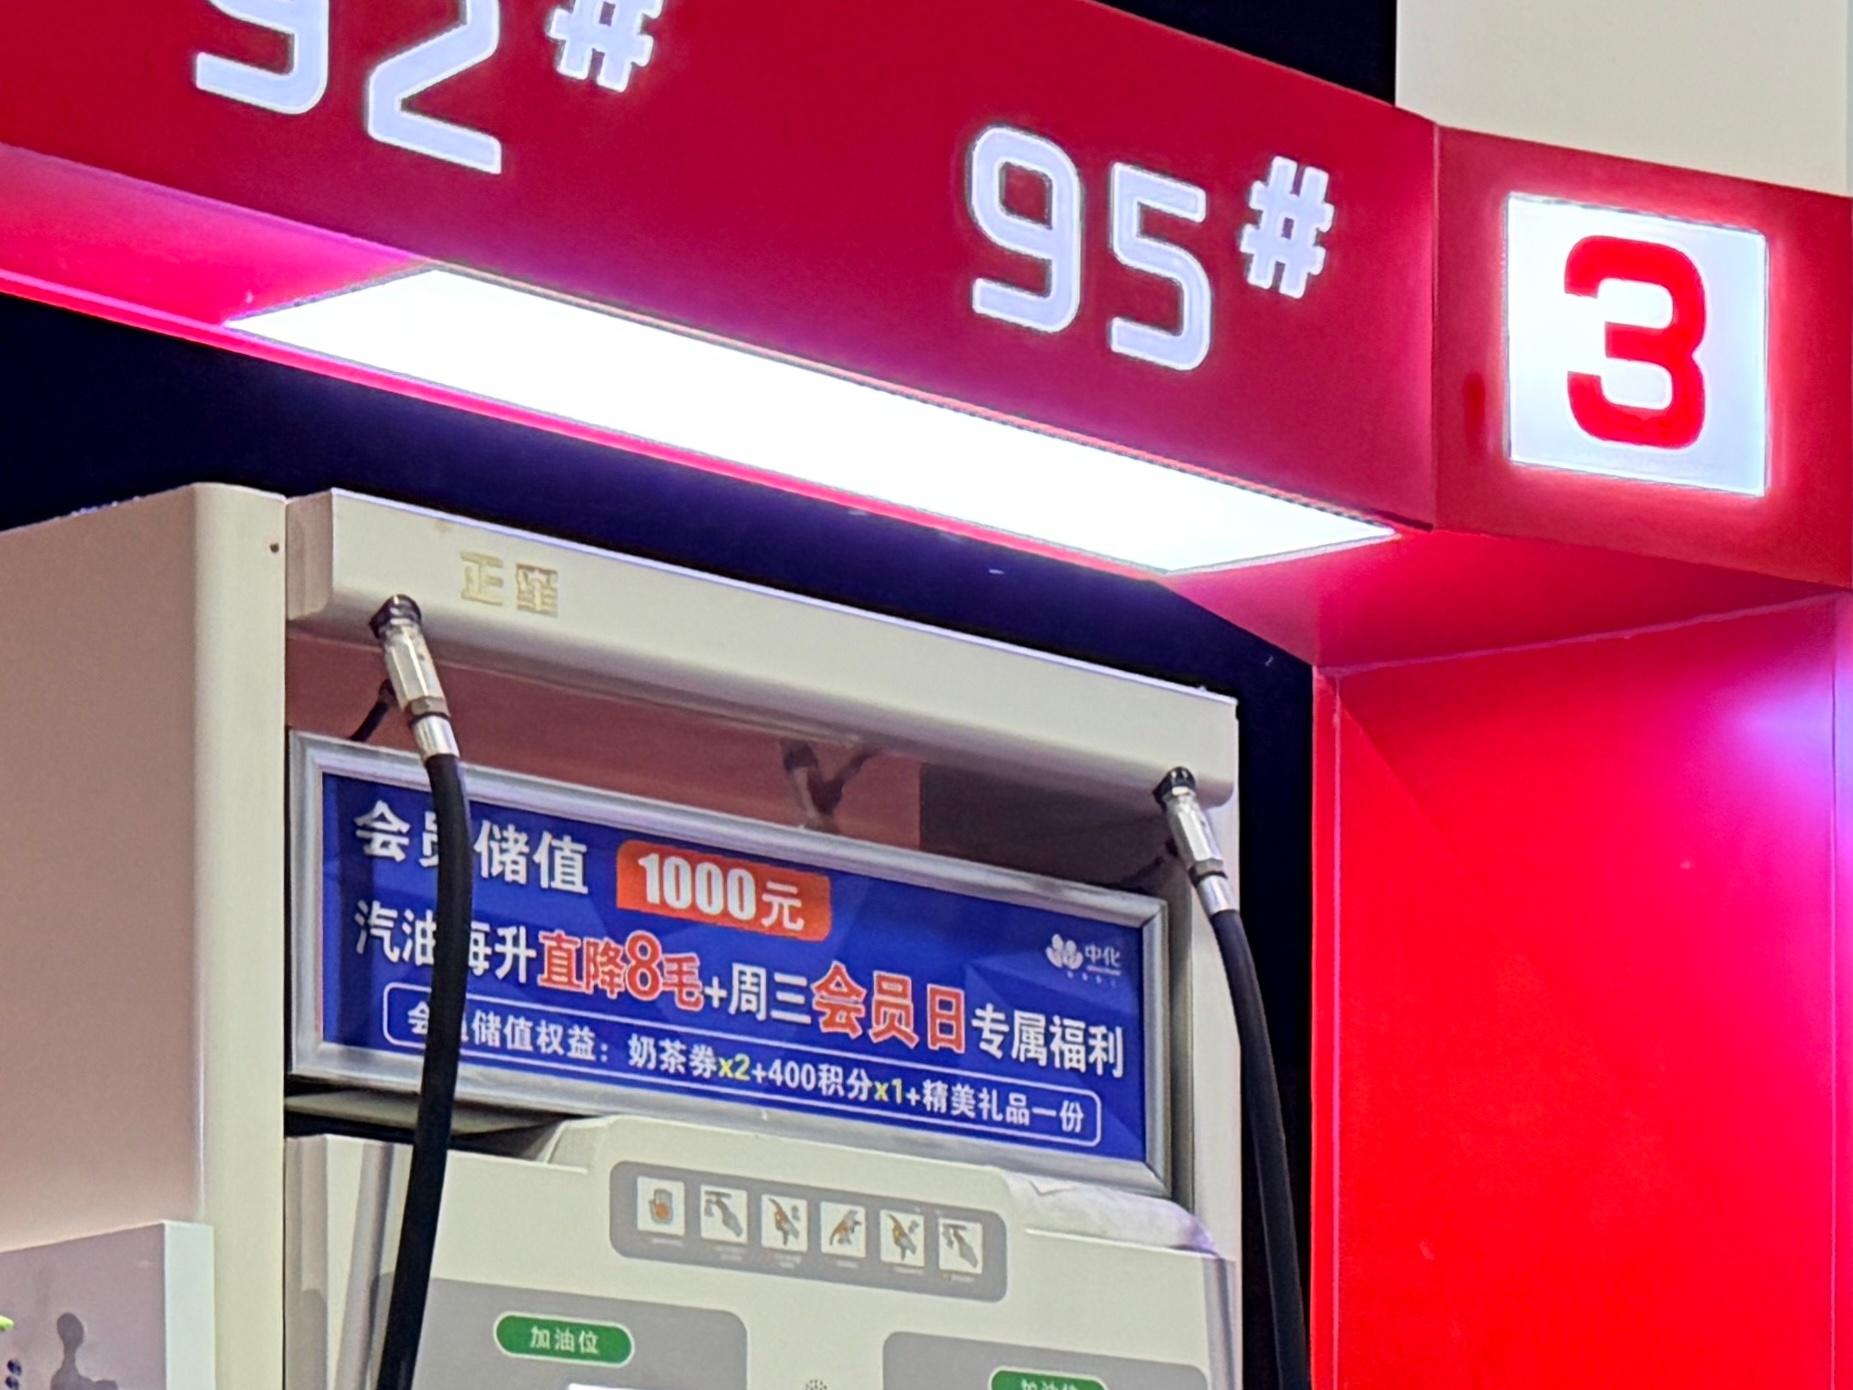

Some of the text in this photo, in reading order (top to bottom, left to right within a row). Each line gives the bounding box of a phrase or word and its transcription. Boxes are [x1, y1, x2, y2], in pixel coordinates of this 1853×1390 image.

[968, 124, 1336, 372] 95#
[1564, 233, 1707, 450] 3
[637, 852, 806, 932] 1000元
[529, 1325, 600, 1354] 加油位
